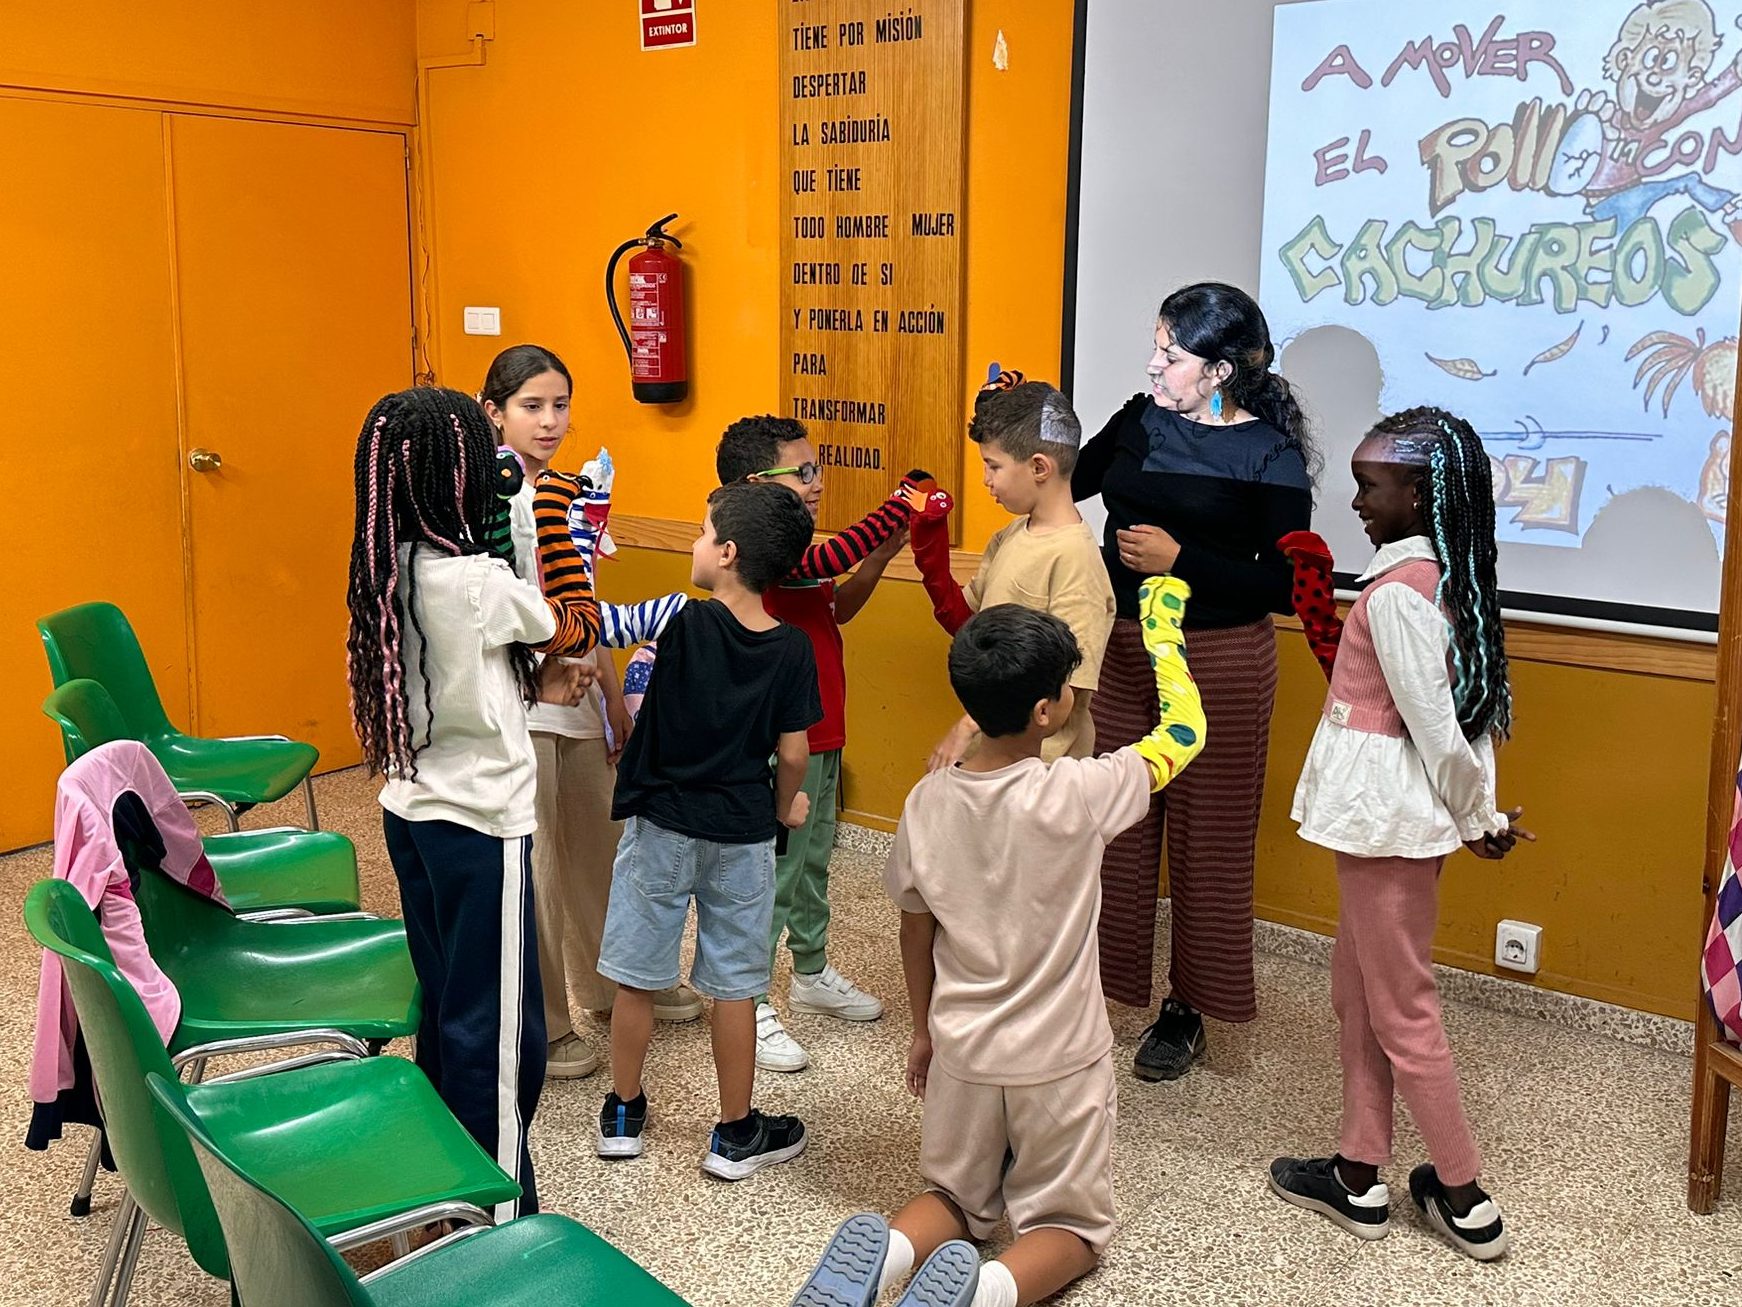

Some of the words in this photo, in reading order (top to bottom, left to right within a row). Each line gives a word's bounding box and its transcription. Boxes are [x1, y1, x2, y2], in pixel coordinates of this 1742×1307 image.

[648, 23, 688, 37] EXTINTOR
[839, 22, 864, 47] POR
[1301, 45, 1373, 91] A
[1381, 15, 1574, 98] MOVER
[793, 71, 866, 99] DESPERTAR
[793, 123, 809, 146] LA
[1314, 129, 1387, 186] EL
[793, 170, 816, 195] QUE
[794, 217, 825, 239] TODO
[836, 215, 889, 239] HOMBRE
[912, 213, 954, 237] MUJER
[1279, 205, 1728, 317] CACHUREOS
[793, 263, 840, 285] DENTRO
[852, 263, 867, 286] DE
[881, 263, 893, 286] SI
[794, 309, 801, 330] Y
[809, 309, 863, 332] PONERLA
[874, 310, 889, 333] EN
[898, 303, 945, 334] ACCIÓN
[793, 353, 827, 375] PARA
[793, 398, 885, 425] TRANSFORMAR
[819, 444, 885, 470] REALIDAD.
